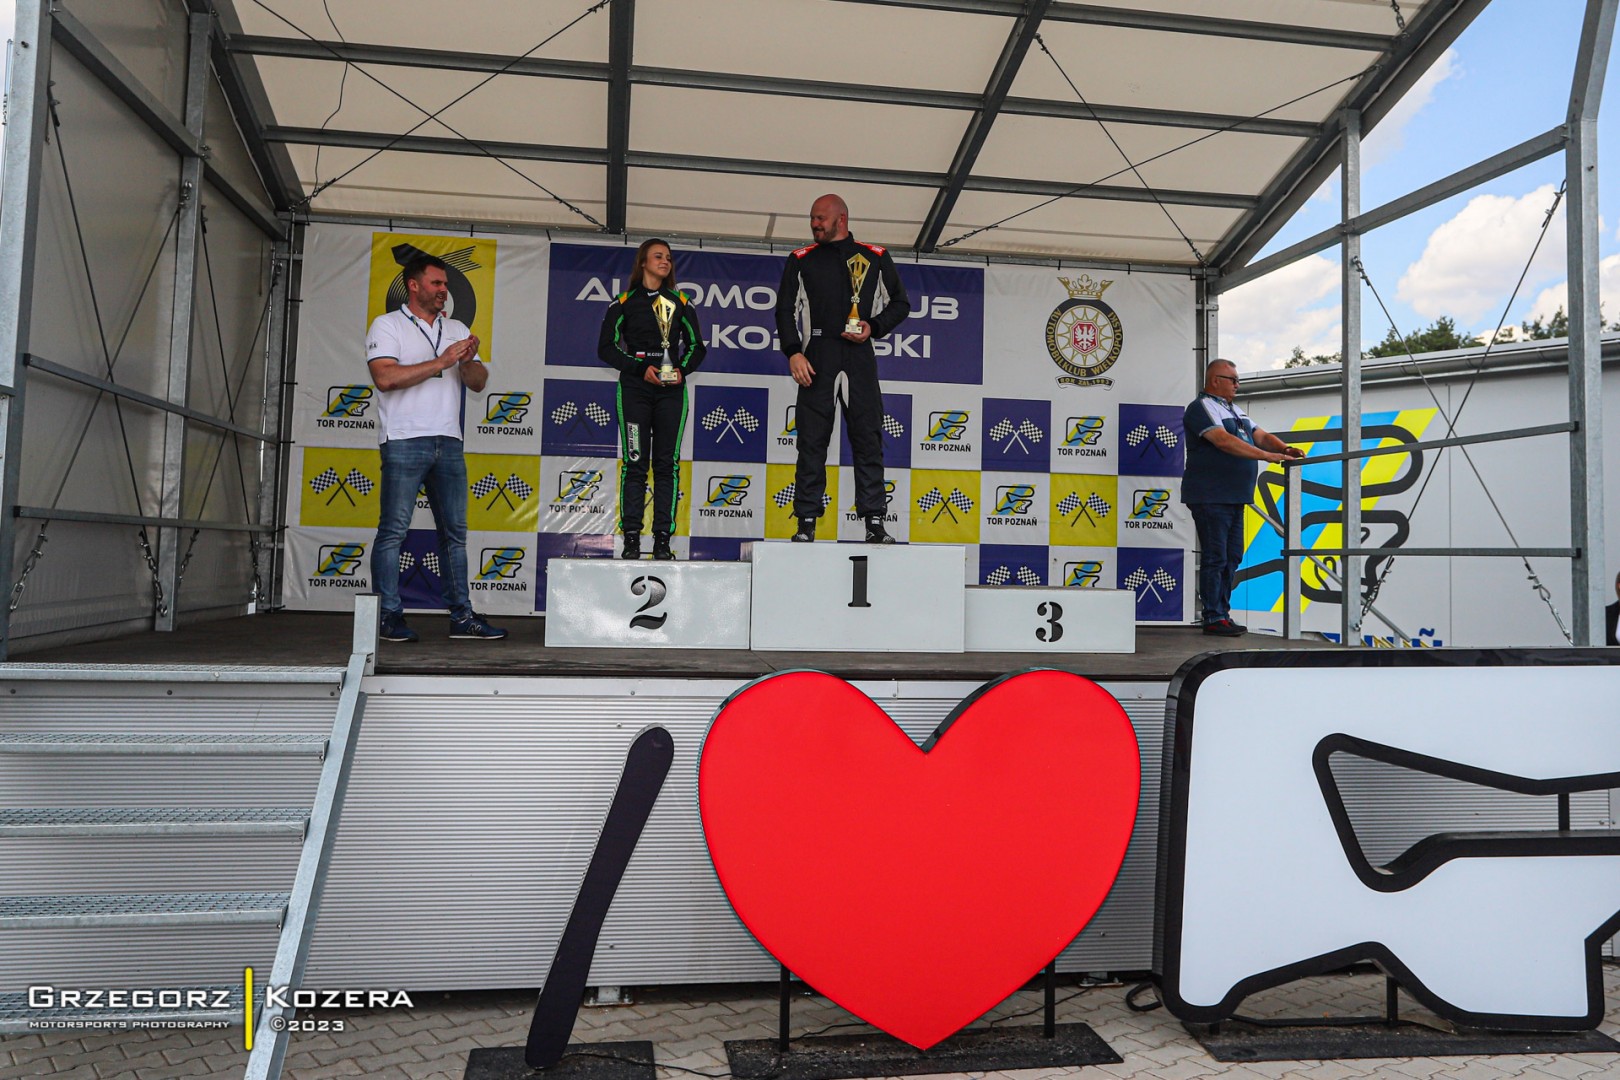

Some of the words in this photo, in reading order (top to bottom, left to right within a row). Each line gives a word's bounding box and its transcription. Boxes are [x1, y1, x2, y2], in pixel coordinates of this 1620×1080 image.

[316, 419, 335, 428] TOR
[476, 425, 495, 435] TOR
[776, 437, 794, 446] TOR
[919, 442, 937, 451] TOR
[1057, 447, 1073, 456] TOR
[698, 508, 716, 517] TOR
[986, 516, 1003, 525] TOR
[1124, 520, 1140, 529] TOR
[307, 578, 327, 587] TOR
[469, 581, 488, 591] TOR
[847, 555, 872, 608] 1
[629, 575, 668, 630] 2
[1035, 601, 1064, 643] 3
